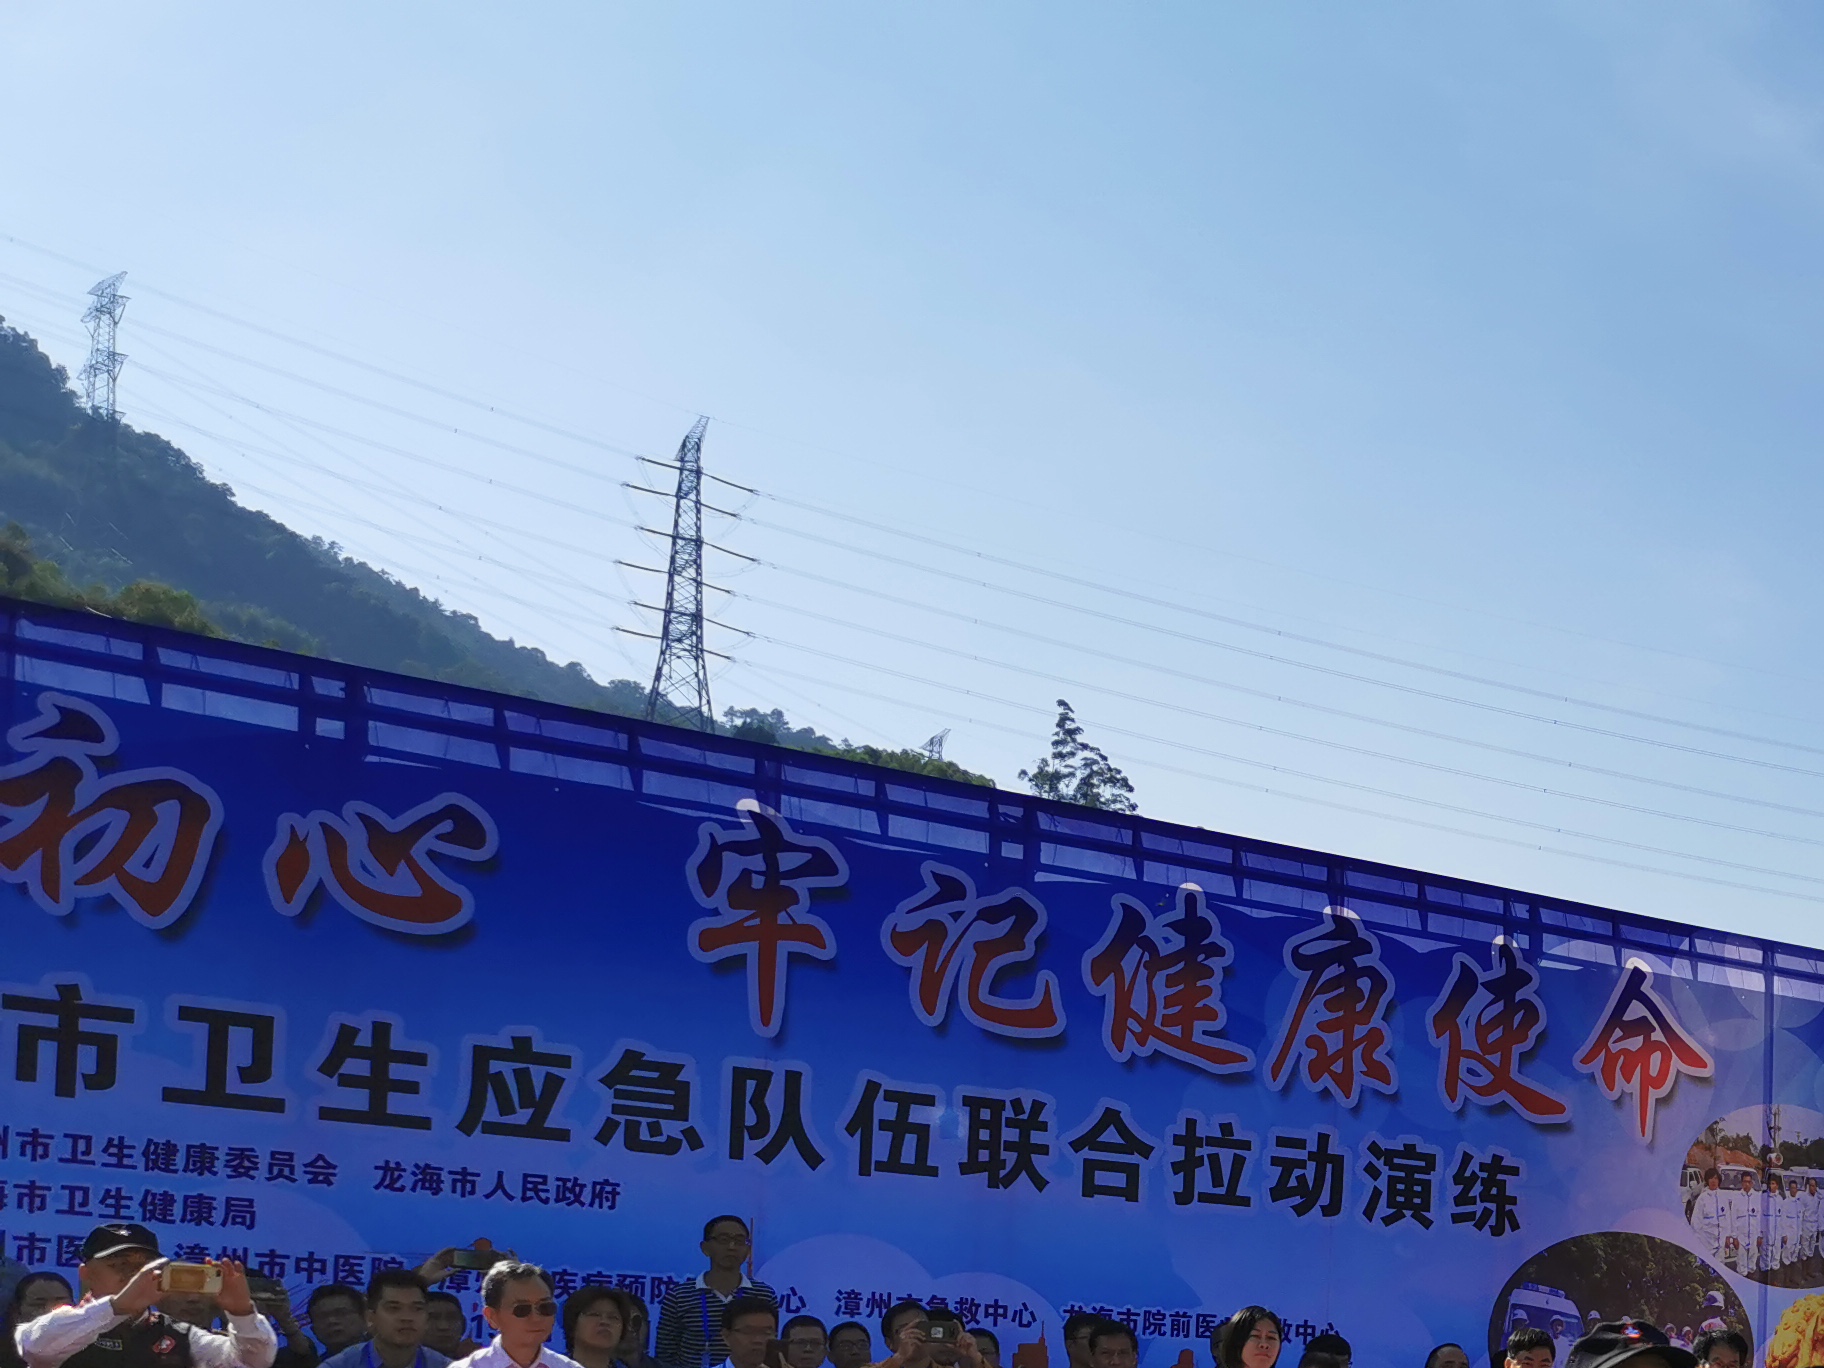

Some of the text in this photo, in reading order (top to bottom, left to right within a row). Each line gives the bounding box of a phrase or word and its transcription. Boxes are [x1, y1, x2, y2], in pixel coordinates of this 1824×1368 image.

[0, 700, 1708, 1138] 初心 牢记健康使命
[0, 983, 1522, 1238] 市卫生应急队伍联合拉动演练
[373, 1160, 622, 1211] 龙海市人民政府
